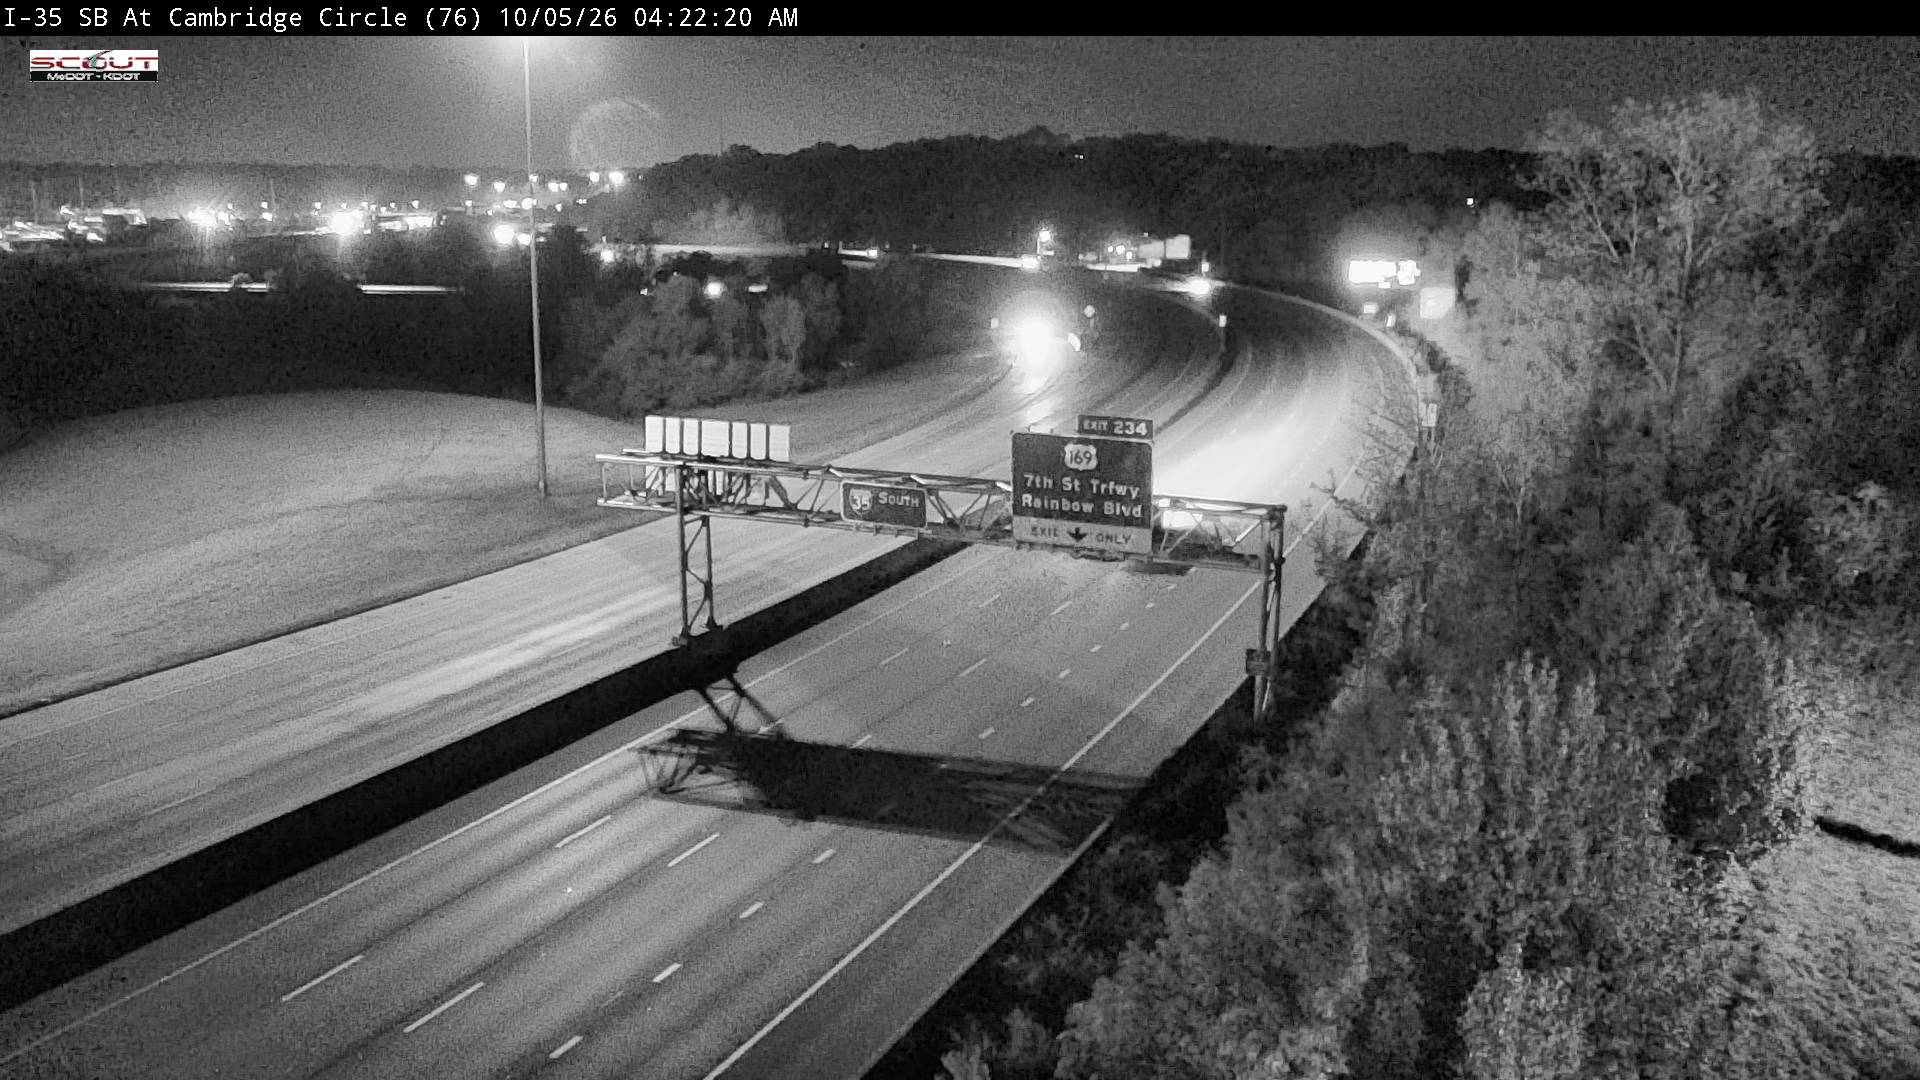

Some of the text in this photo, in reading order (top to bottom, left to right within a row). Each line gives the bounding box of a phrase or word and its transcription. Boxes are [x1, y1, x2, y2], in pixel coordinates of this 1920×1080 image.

[1082, 419, 1148, 436] EXIT 234
[1069, 450, 1094, 465] 169
[1023, 473, 1141, 500] 7th St Trfwy
[852, 491, 921, 511] 35 SOUTH
[1021, 493, 1144, 518] Rainbow Blvd
[1096, 532, 1133, 545] ONLY
